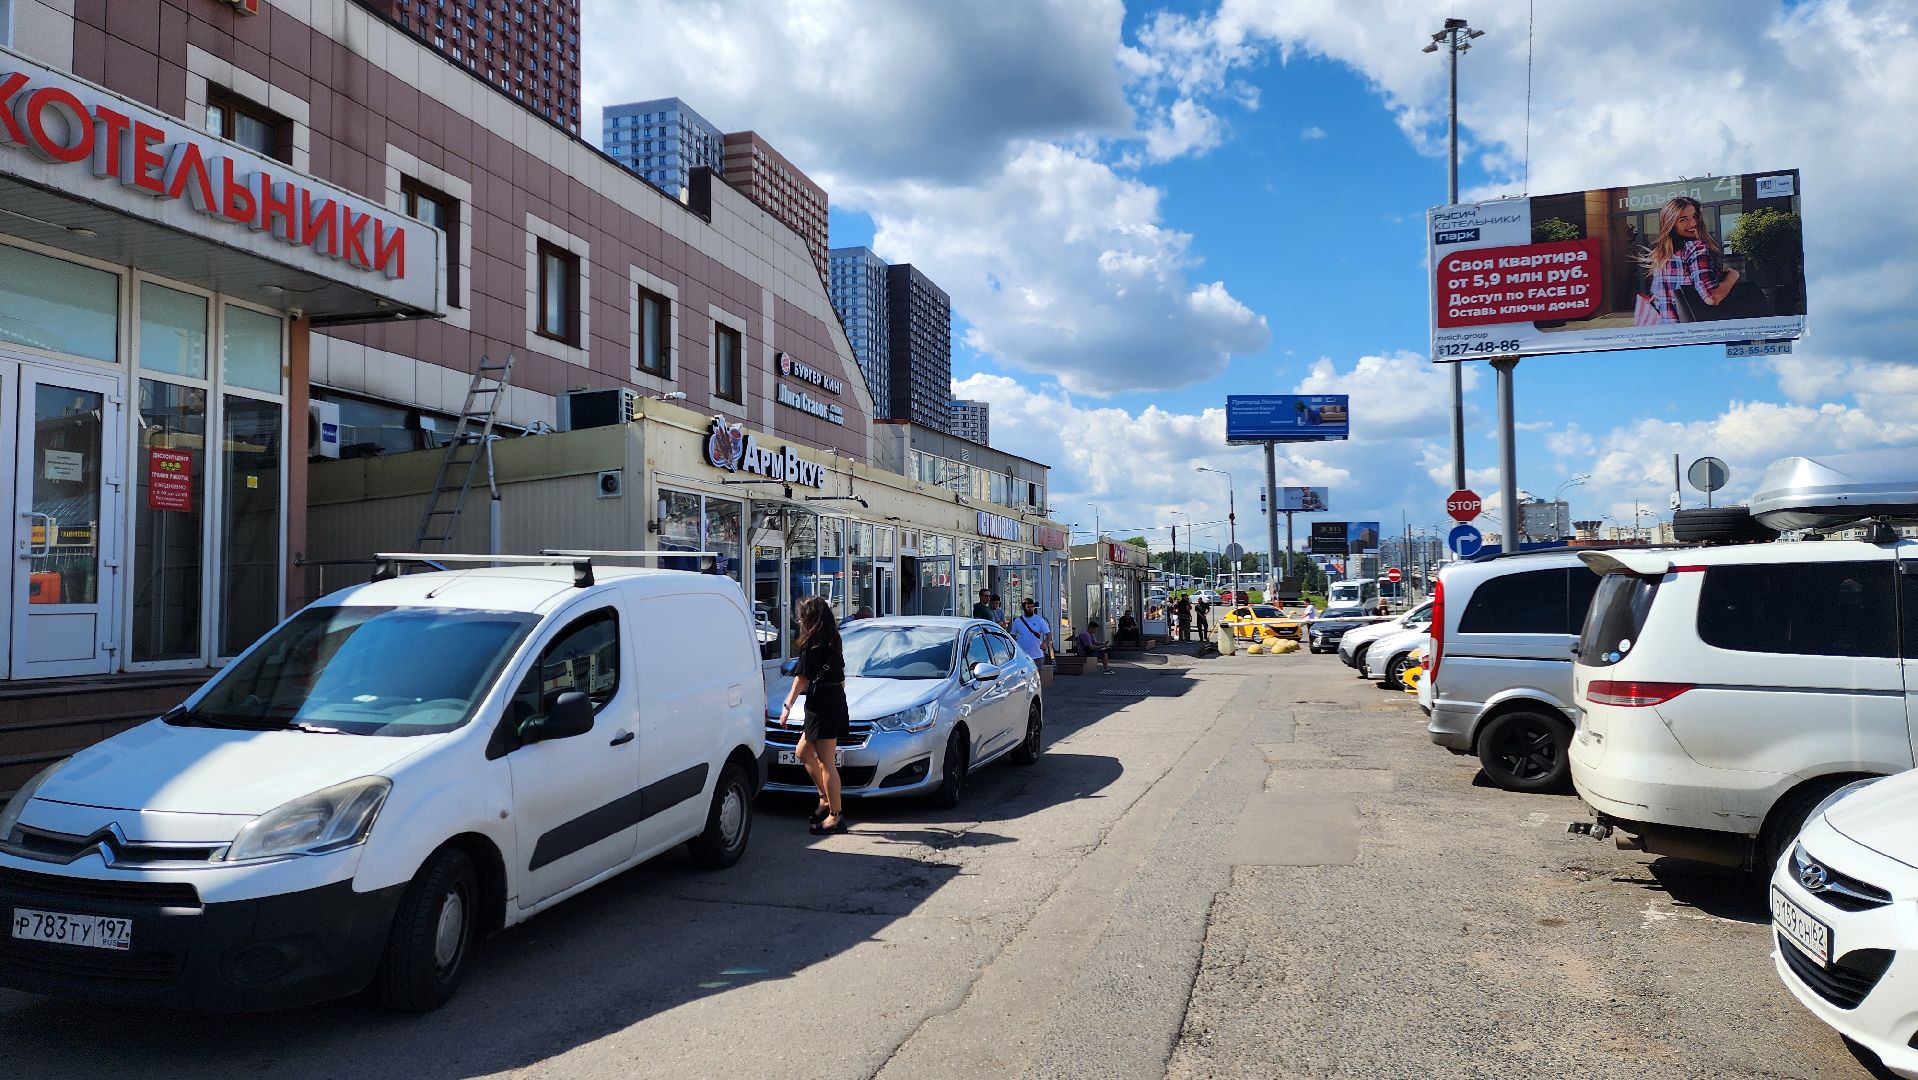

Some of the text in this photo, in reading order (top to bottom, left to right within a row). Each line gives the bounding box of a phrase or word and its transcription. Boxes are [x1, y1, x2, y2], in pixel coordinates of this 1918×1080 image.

[0, 72, 405, 280] КОТЕЛЬНИКИ
[1434, 215, 1521, 231] КОТЕЛЬНИКИ
[1448, 250, 1588, 272] Своя квартира
[1448, 265, 1589, 289] от 5,9 млн руб.
[1449, 293, 1502, 307] Доступ
[1506, 291, 1524, 301] по
[1528, 286, 1567, 299] FACE
[1449, 298, 1590, 318] Оставь ключи дома!
[1444, 339, 1520, 356] 127-48-86
[794, 361, 822, 386] БУРГЕР
[823, 375, 842, 396] КИНГ
[1447, 501, 1481, 511] STOP
[98, 918, 127, 940] 197
[102, 938, 118, 947] RUS
